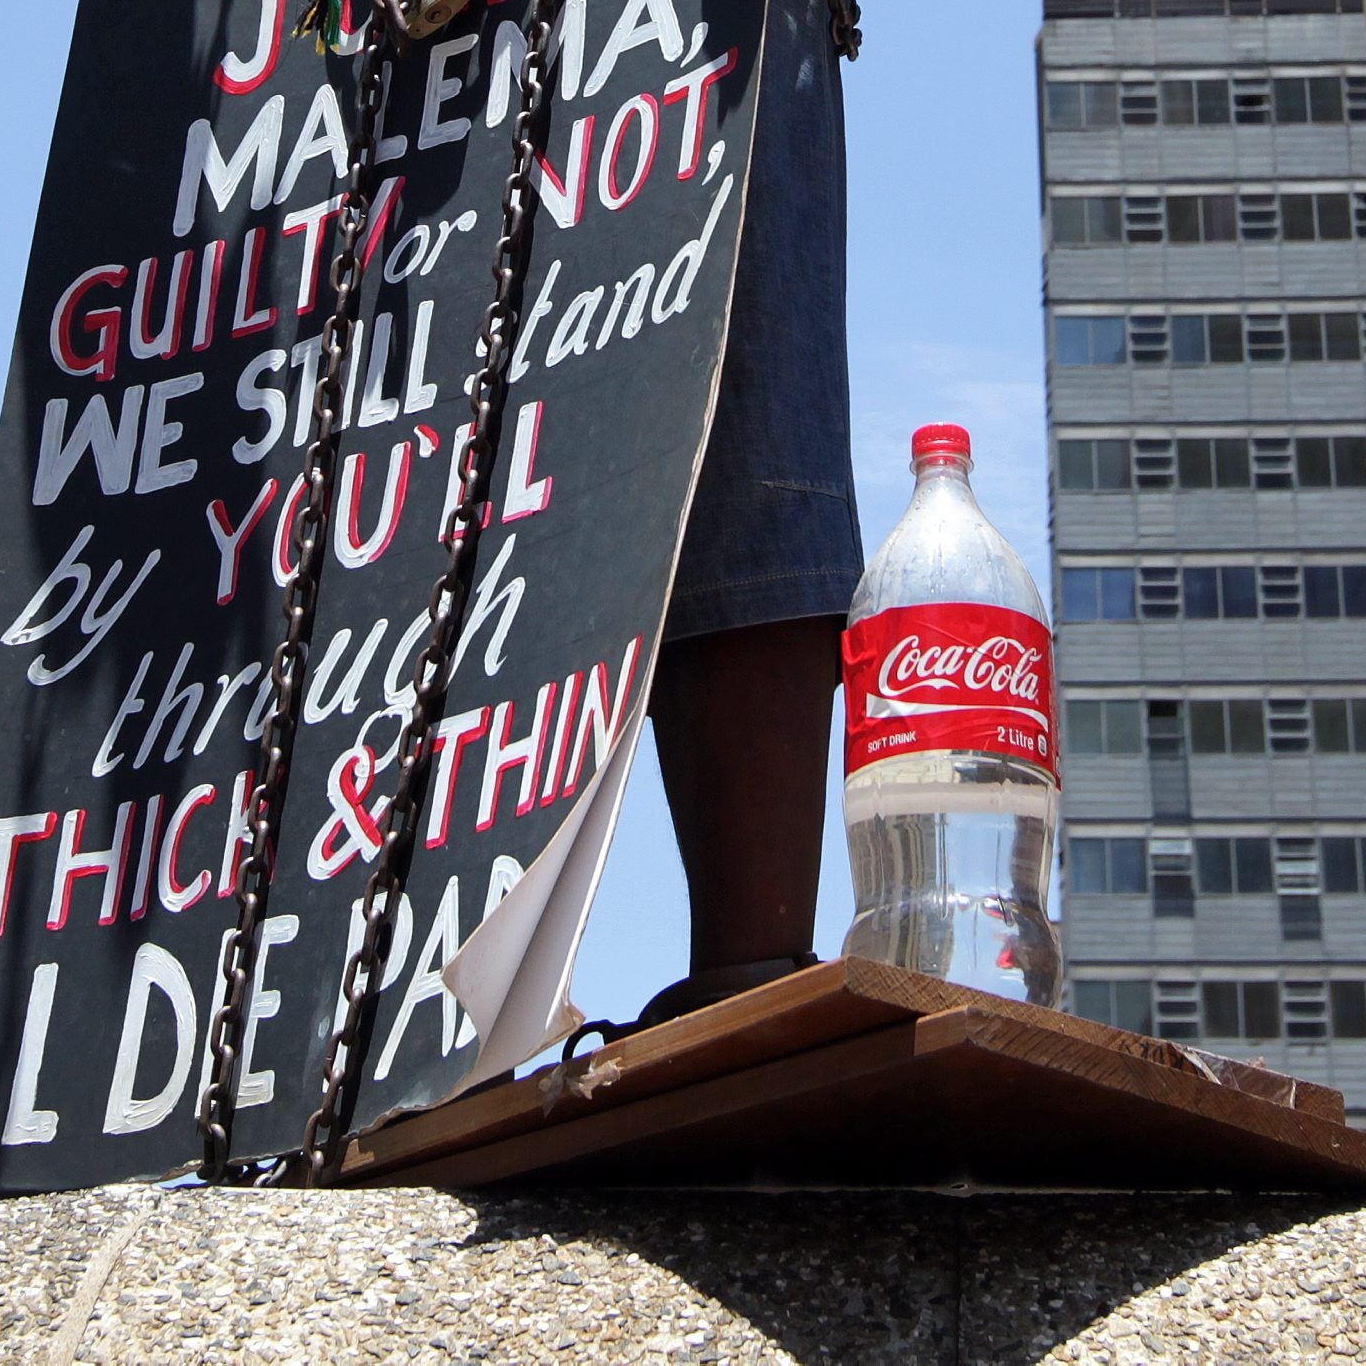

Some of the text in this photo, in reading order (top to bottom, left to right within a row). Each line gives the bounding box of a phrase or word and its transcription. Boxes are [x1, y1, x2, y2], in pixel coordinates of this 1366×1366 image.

[384, 209, 478, 284] or
[32, 372, 204, 506] WE
[232, 300, 438, 465] STILL
[2, 524, 161, 686] by
[878, 635, 1043, 701] Coca-Cola
[307, 744, 392, 880] &
[415, 634, 643, 849] THIN
[868, 726, 1034, 753] SOFT DRINK 2 Litre
